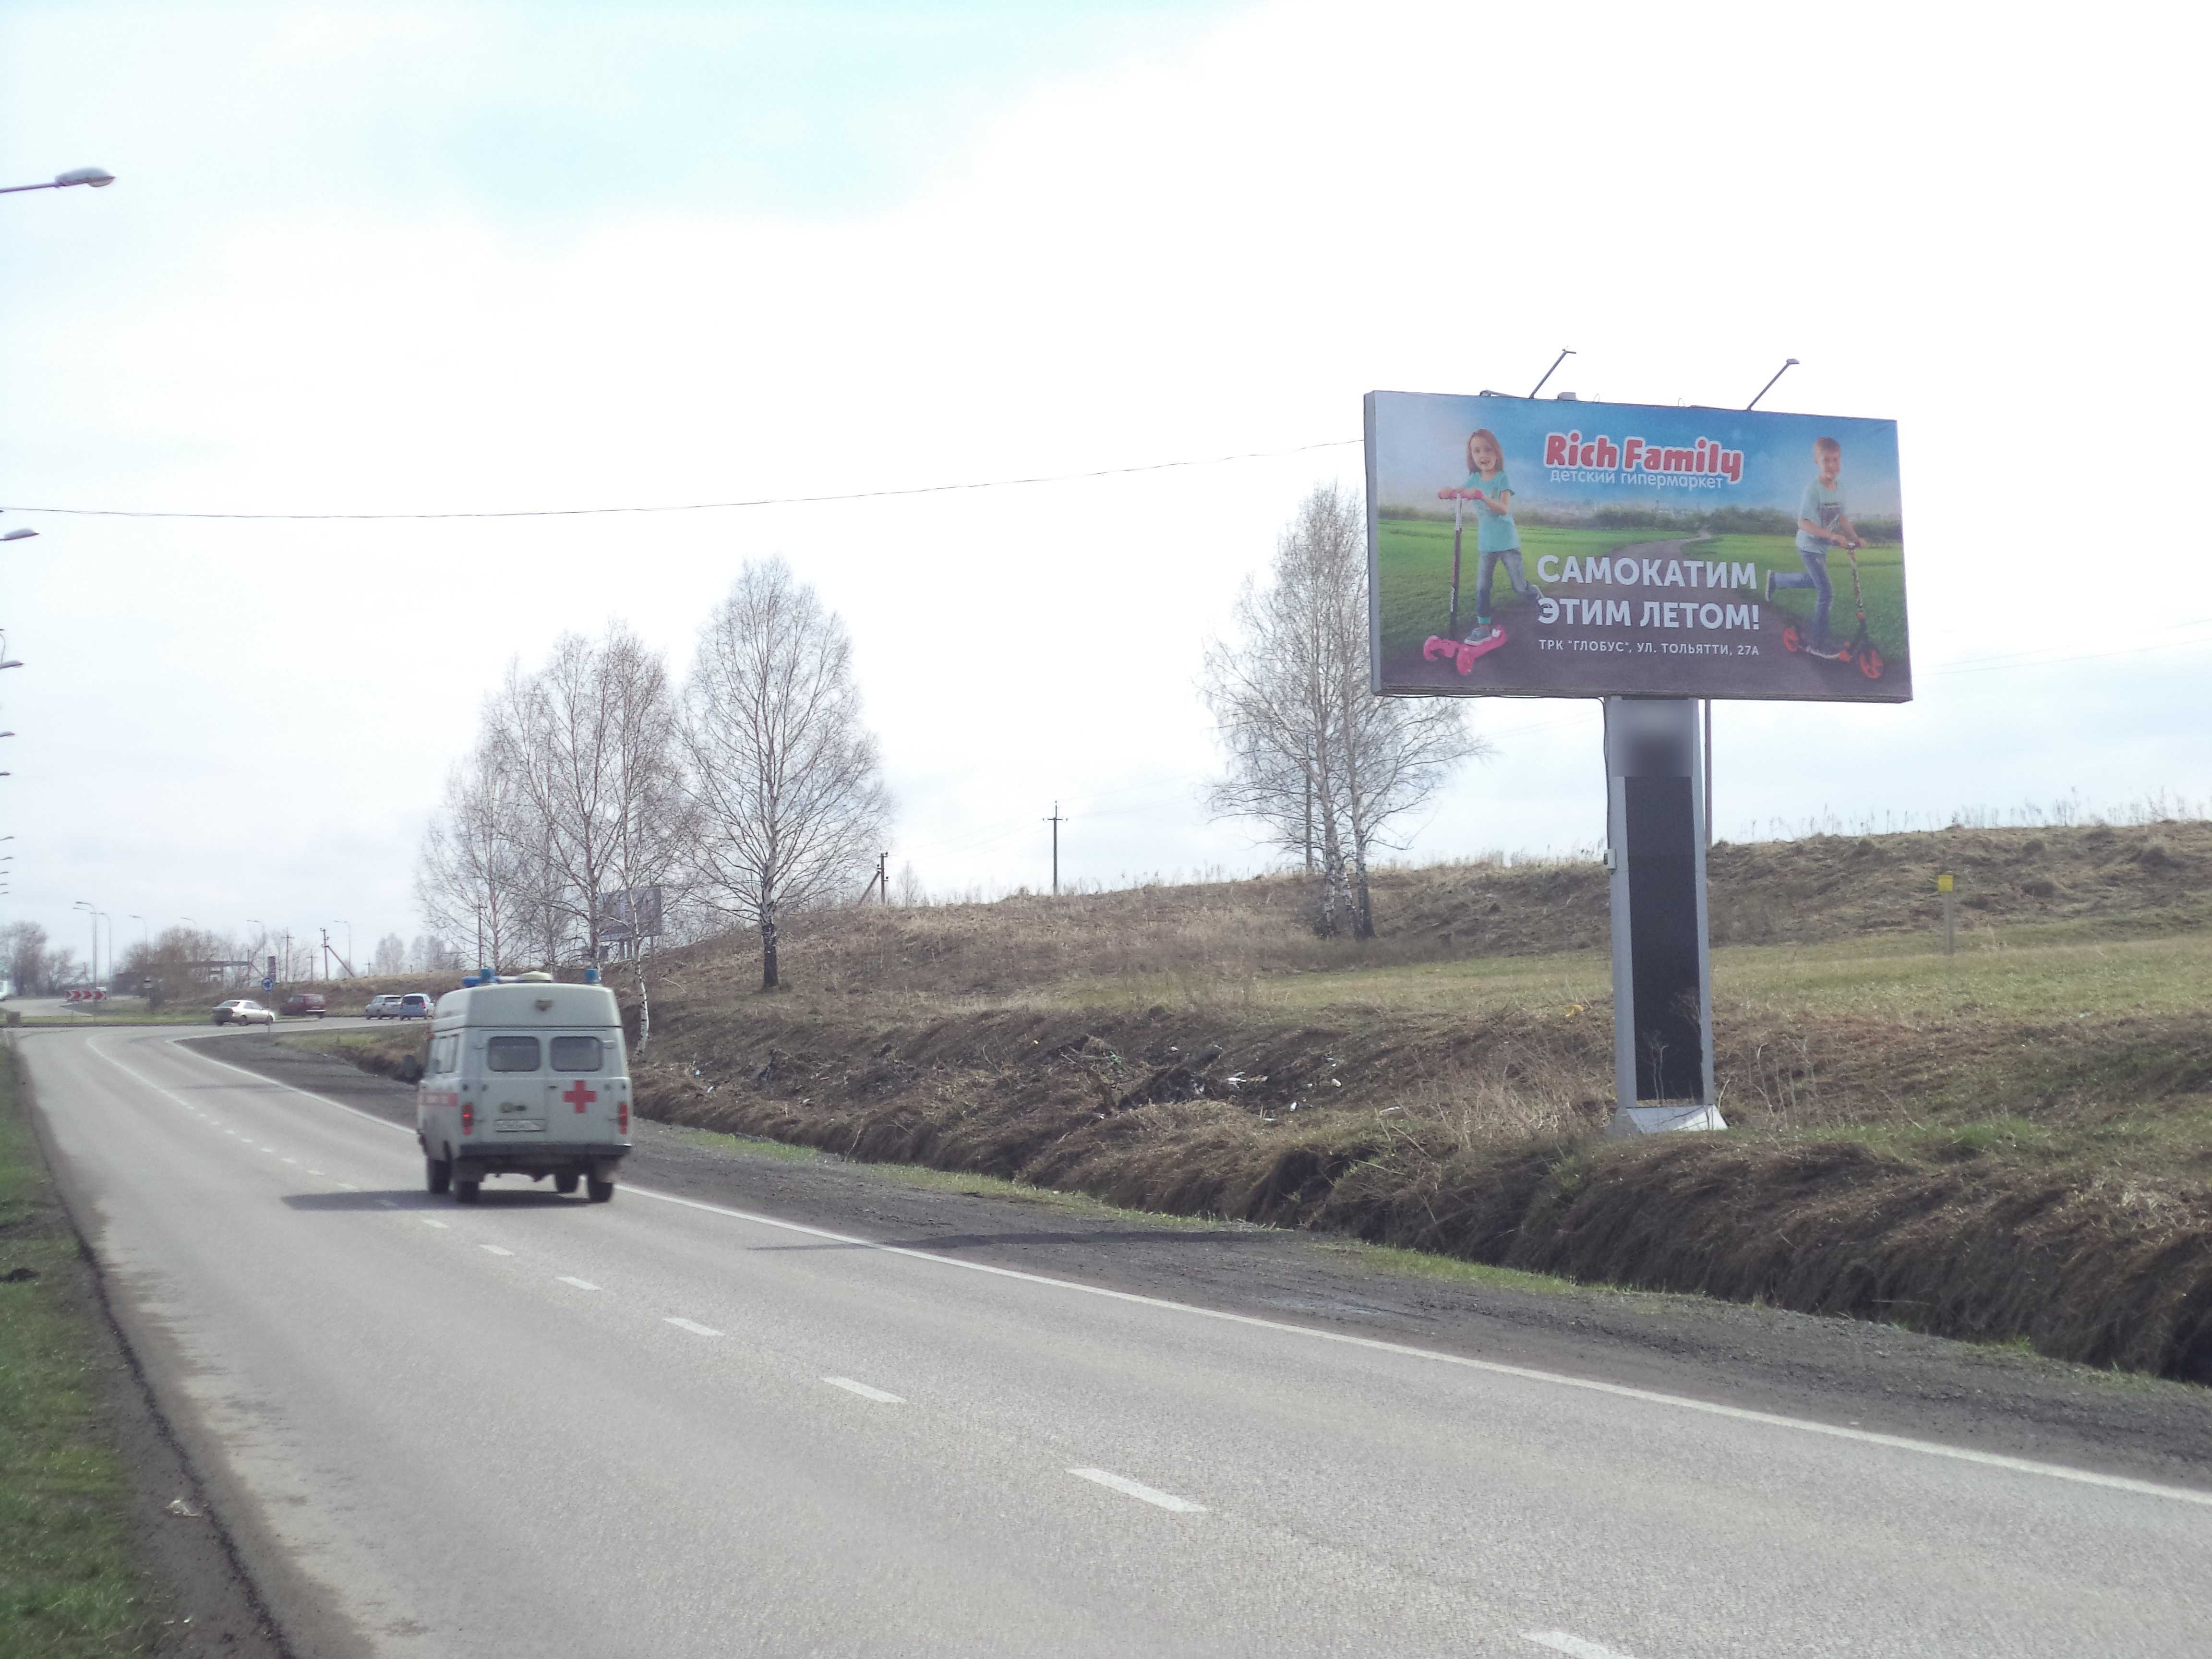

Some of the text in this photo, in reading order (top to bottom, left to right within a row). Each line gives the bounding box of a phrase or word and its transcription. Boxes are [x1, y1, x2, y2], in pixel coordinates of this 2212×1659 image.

[1544, 430, 1743, 483] Rich Family
[1550, 469, 1723, 491] детский гипермаркет
[1538, 554, 1756, 589] САМОКАТИМ
[1538, 598, 1760, 630] ЭТИМ ЛЕТОМ!
[1539, 640, 1563, 650] ТРК
[1637, 643, 1657, 653] УЛ.
[1661, 643, 1732, 657] ТОЛЬЯТТИ,
[1738, 646, 1759, 656] 27А
